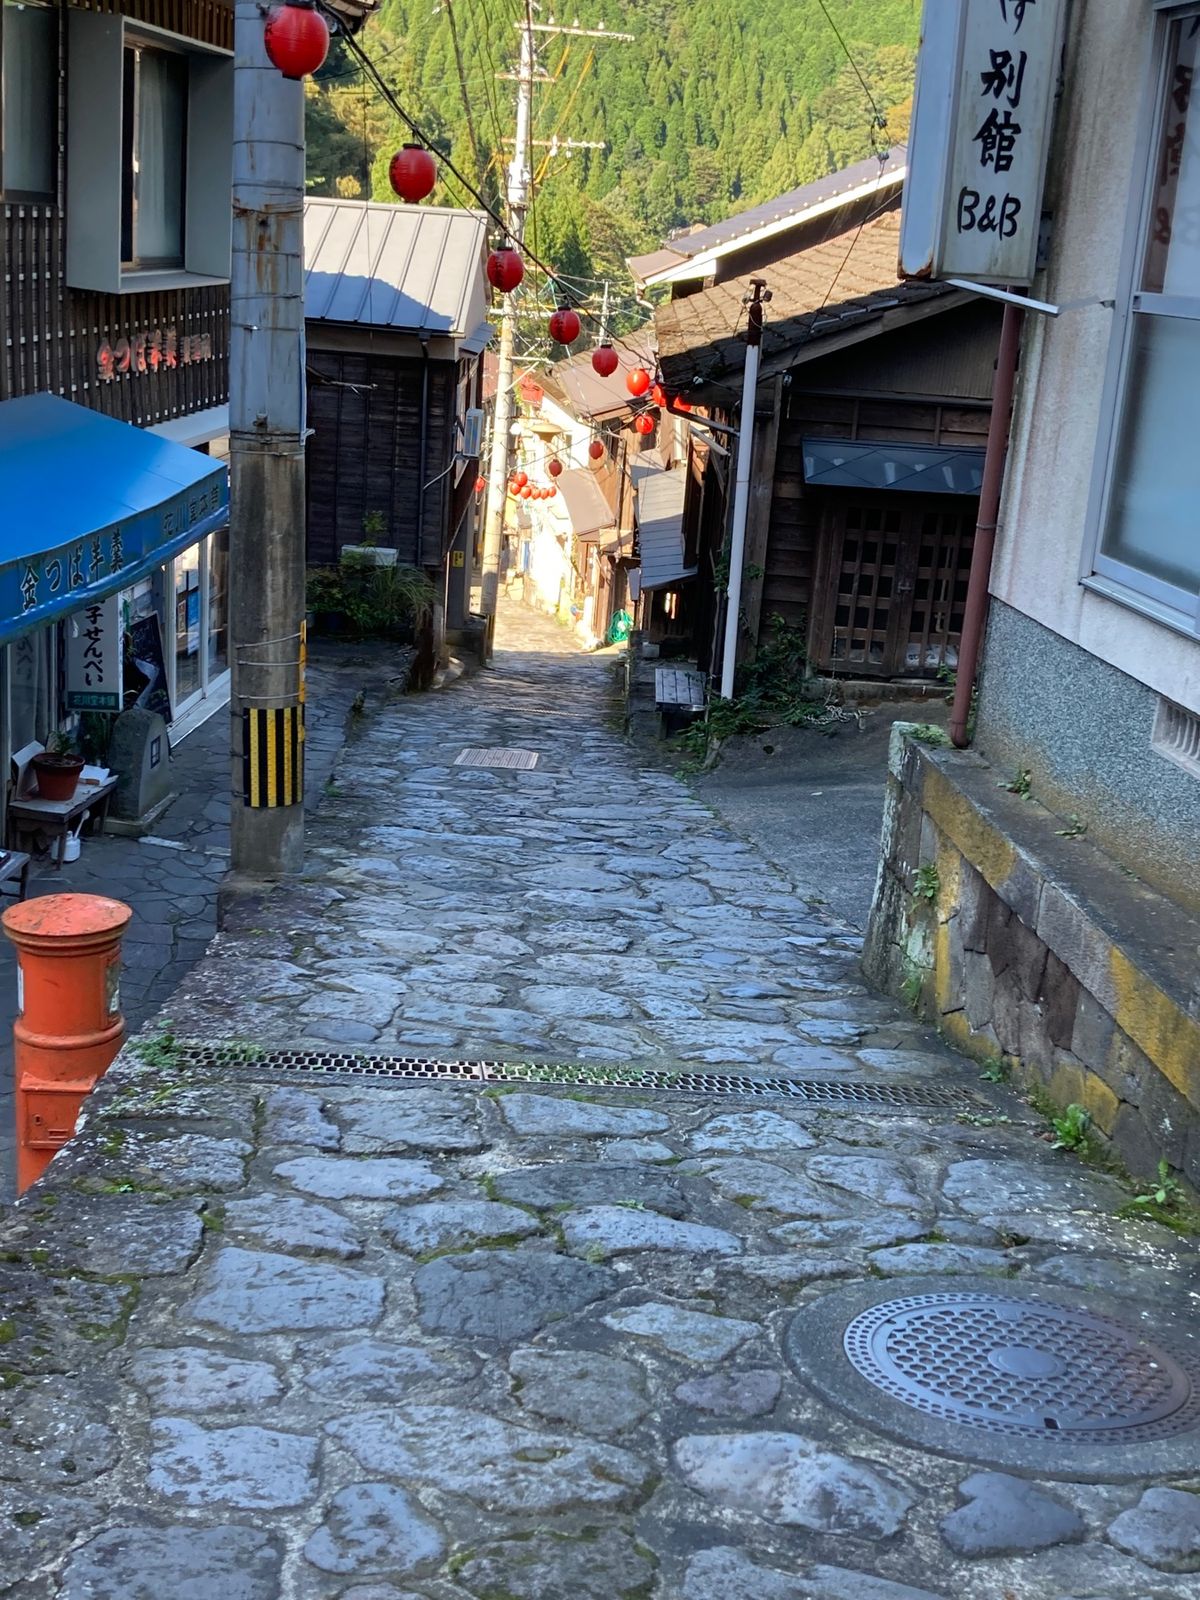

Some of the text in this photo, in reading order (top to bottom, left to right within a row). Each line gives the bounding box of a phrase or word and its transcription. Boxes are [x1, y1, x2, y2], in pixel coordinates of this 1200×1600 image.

[958, 186, 1021, 240] B&B
[82, 599, 104, 686] 子せんべい
